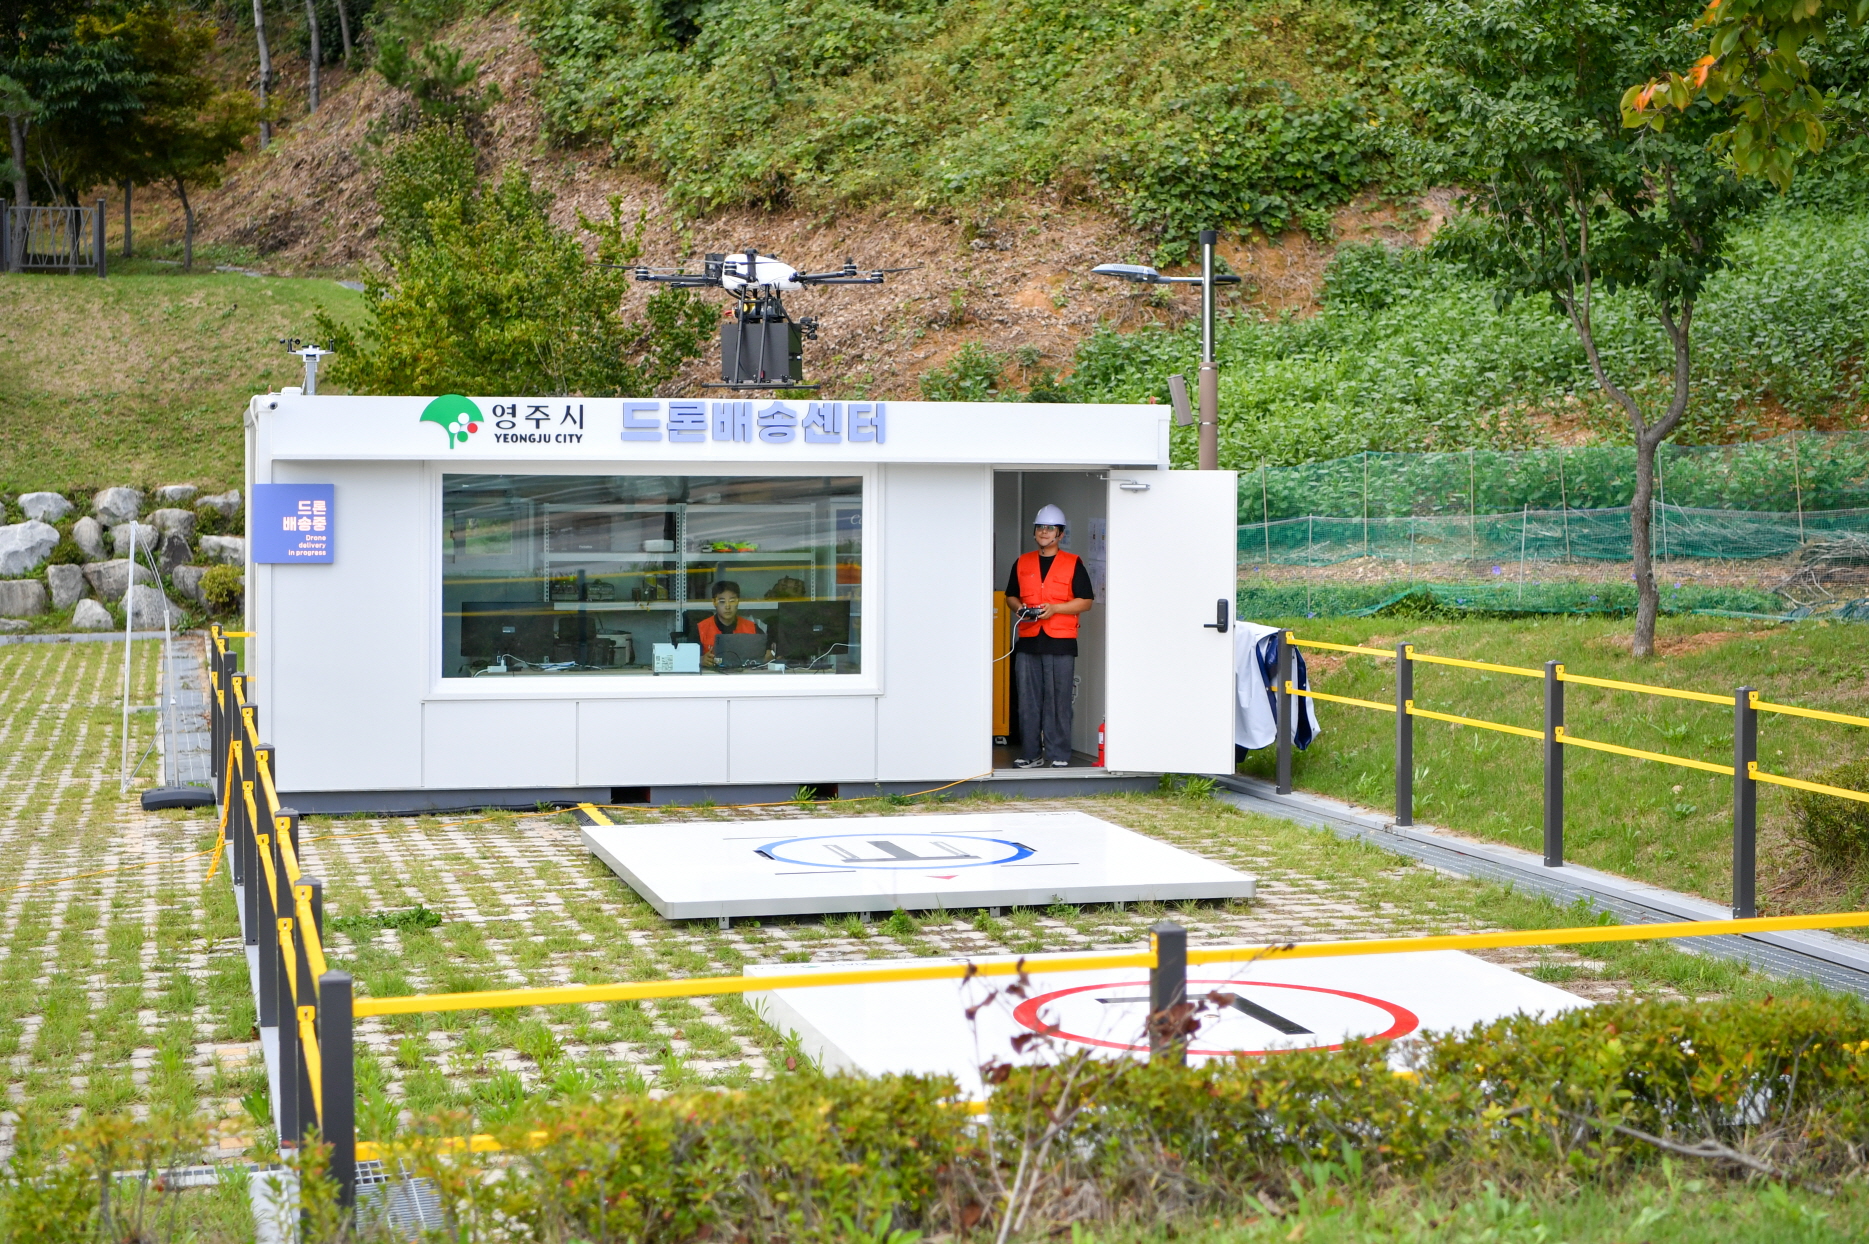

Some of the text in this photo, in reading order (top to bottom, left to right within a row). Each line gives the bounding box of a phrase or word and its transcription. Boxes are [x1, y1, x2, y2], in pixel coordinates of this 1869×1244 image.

[492, 403, 584, 430] 영주시
[621, 400, 886, 444] 드론배송센터
[494, 433, 583, 444] YEONGJU CITY
[297, 500, 327, 515] 드론
[282, 516, 327, 532] 배송중
